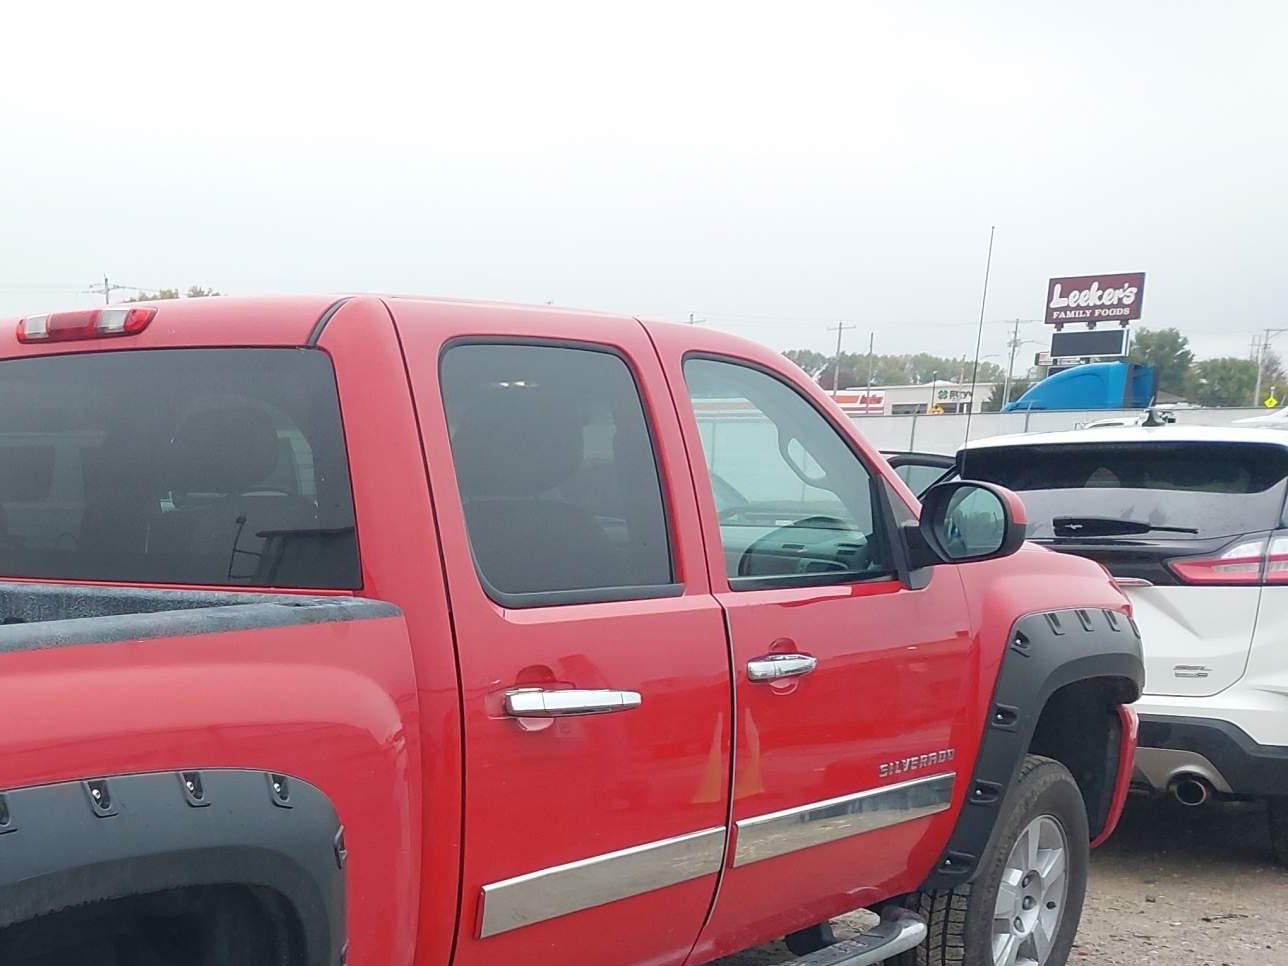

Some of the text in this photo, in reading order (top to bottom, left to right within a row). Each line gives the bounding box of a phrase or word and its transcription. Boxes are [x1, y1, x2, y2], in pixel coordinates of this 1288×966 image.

[1049, 281, 1138, 308] Leeker's
[1052, 307, 1131, 319] FAMILY FOODS
[879, 748, 955, 778] SILVERADO
